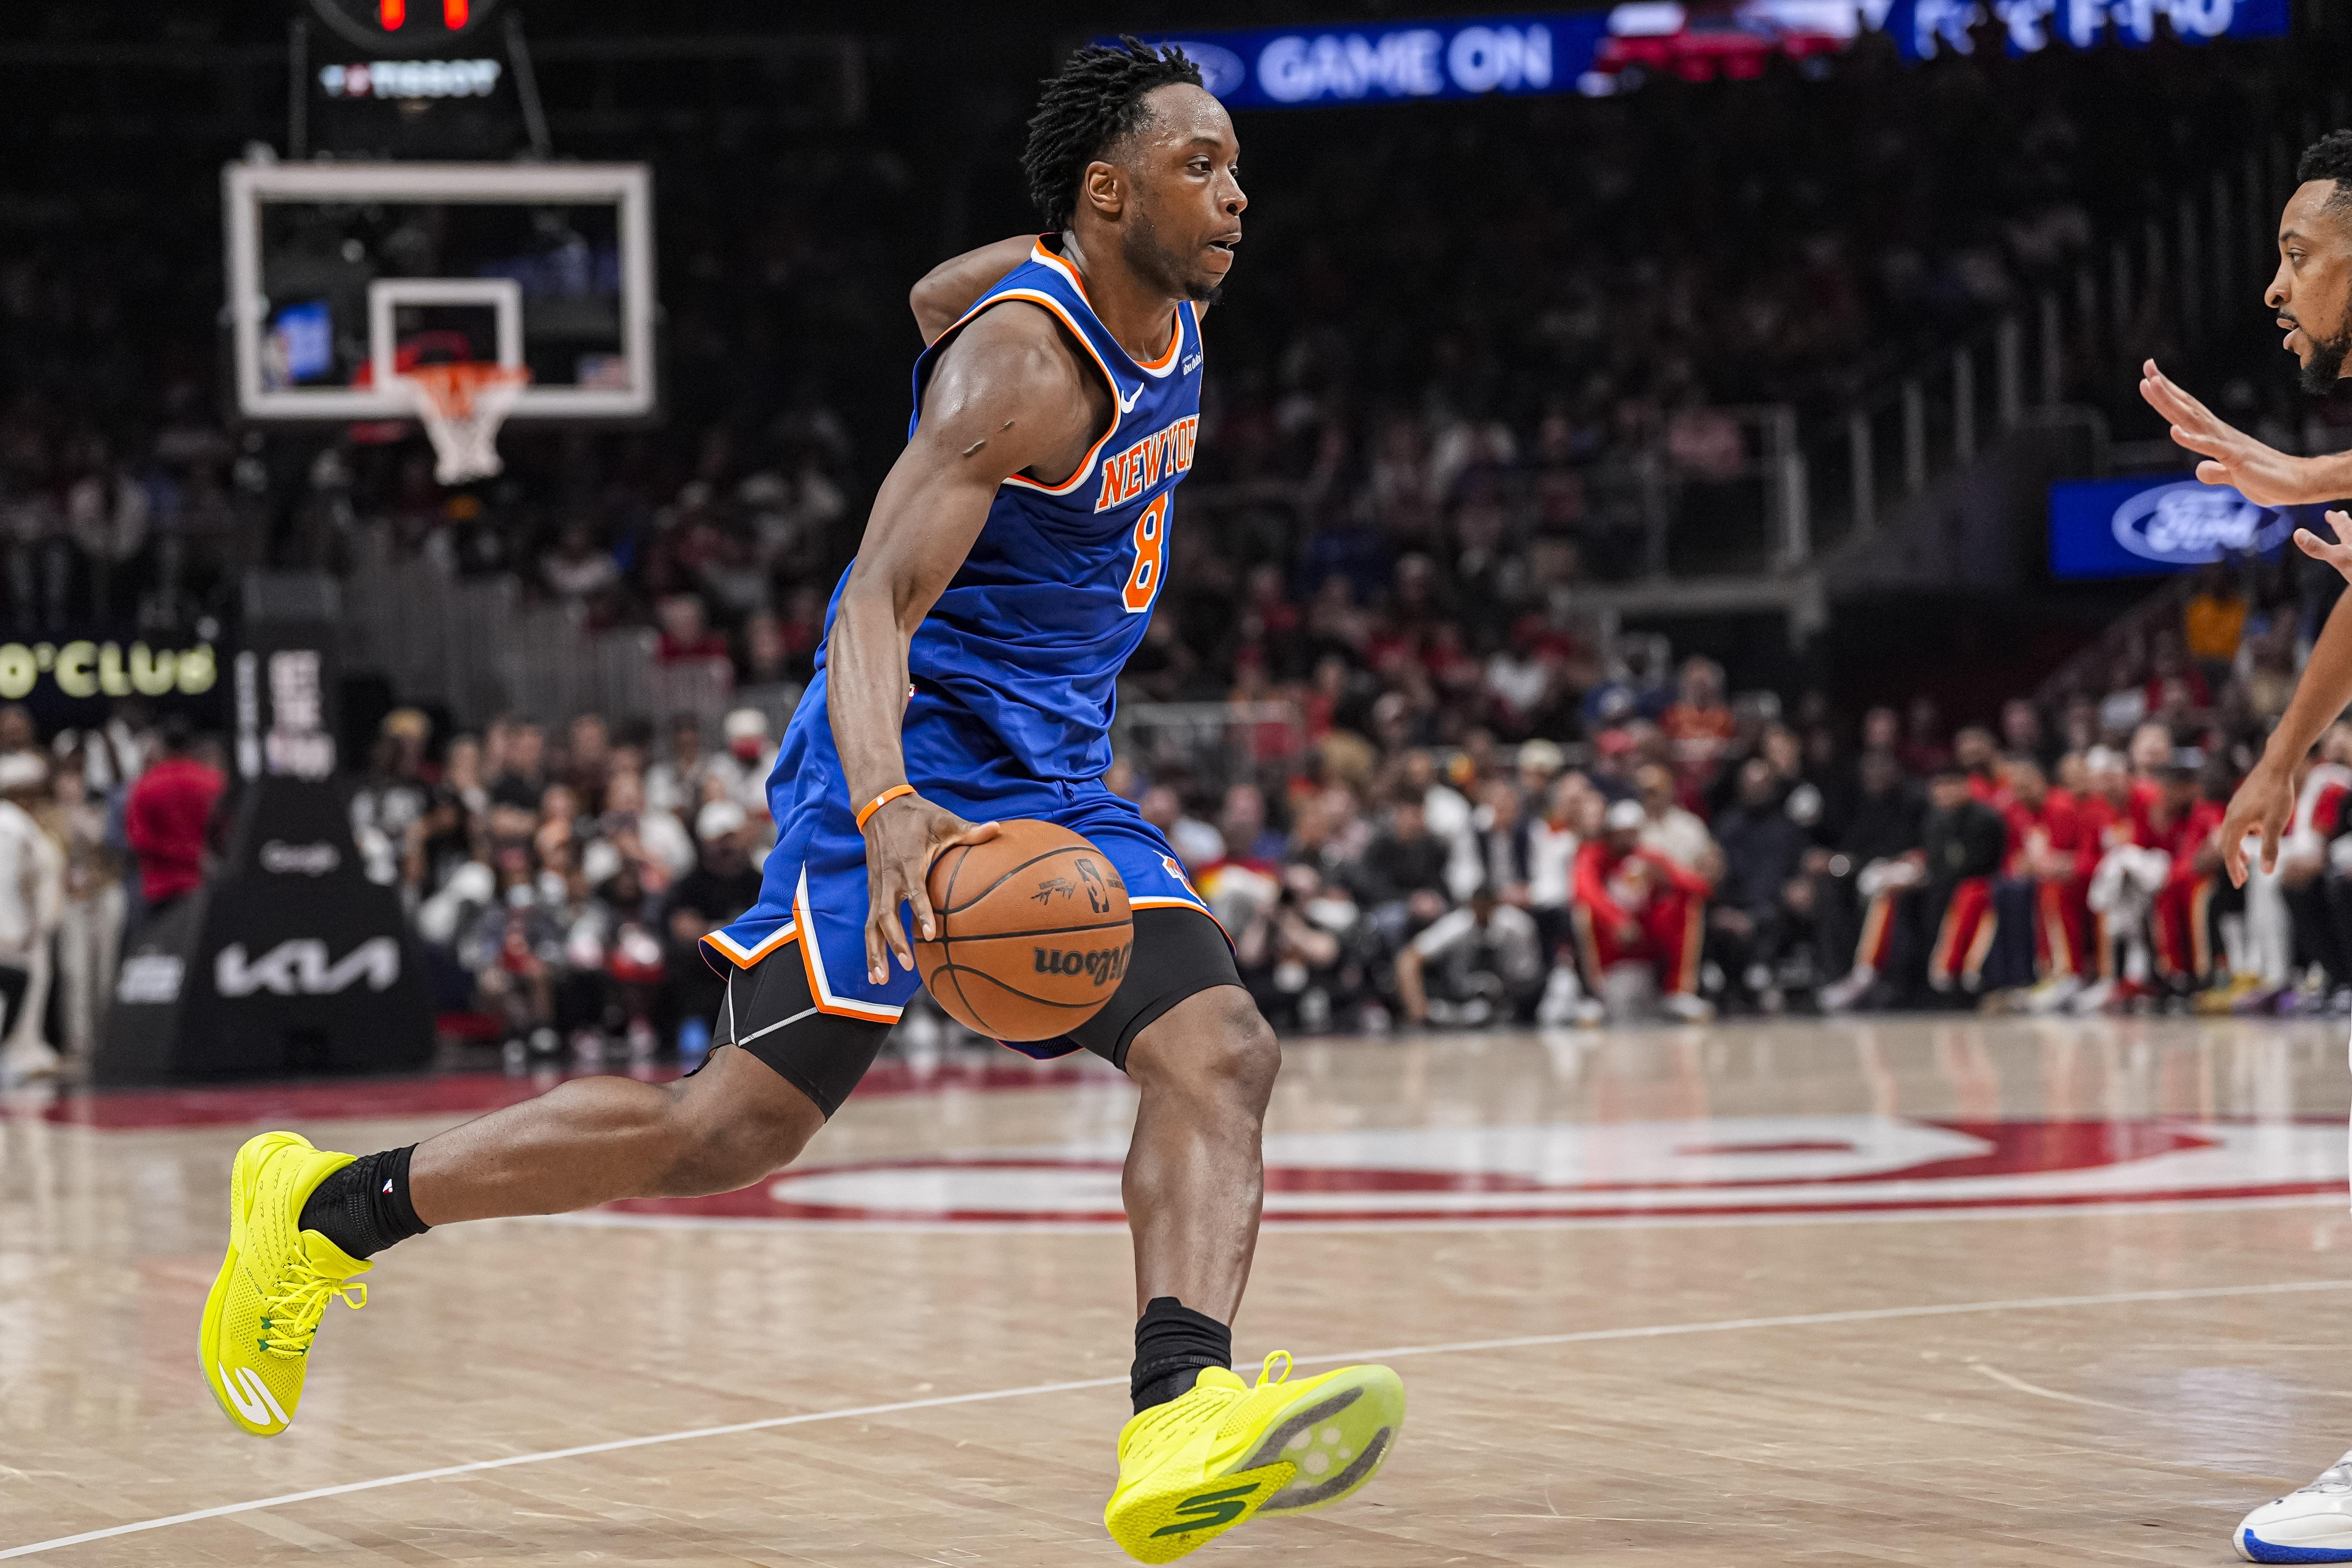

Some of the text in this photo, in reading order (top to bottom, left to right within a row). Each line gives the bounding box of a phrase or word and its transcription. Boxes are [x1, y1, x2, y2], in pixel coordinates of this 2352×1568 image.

[1258, 23, 1553, 102] GAME ON
[1093, 413, 1200, 515] NEW YOR
[1122, 490, 1168, 613] 8
